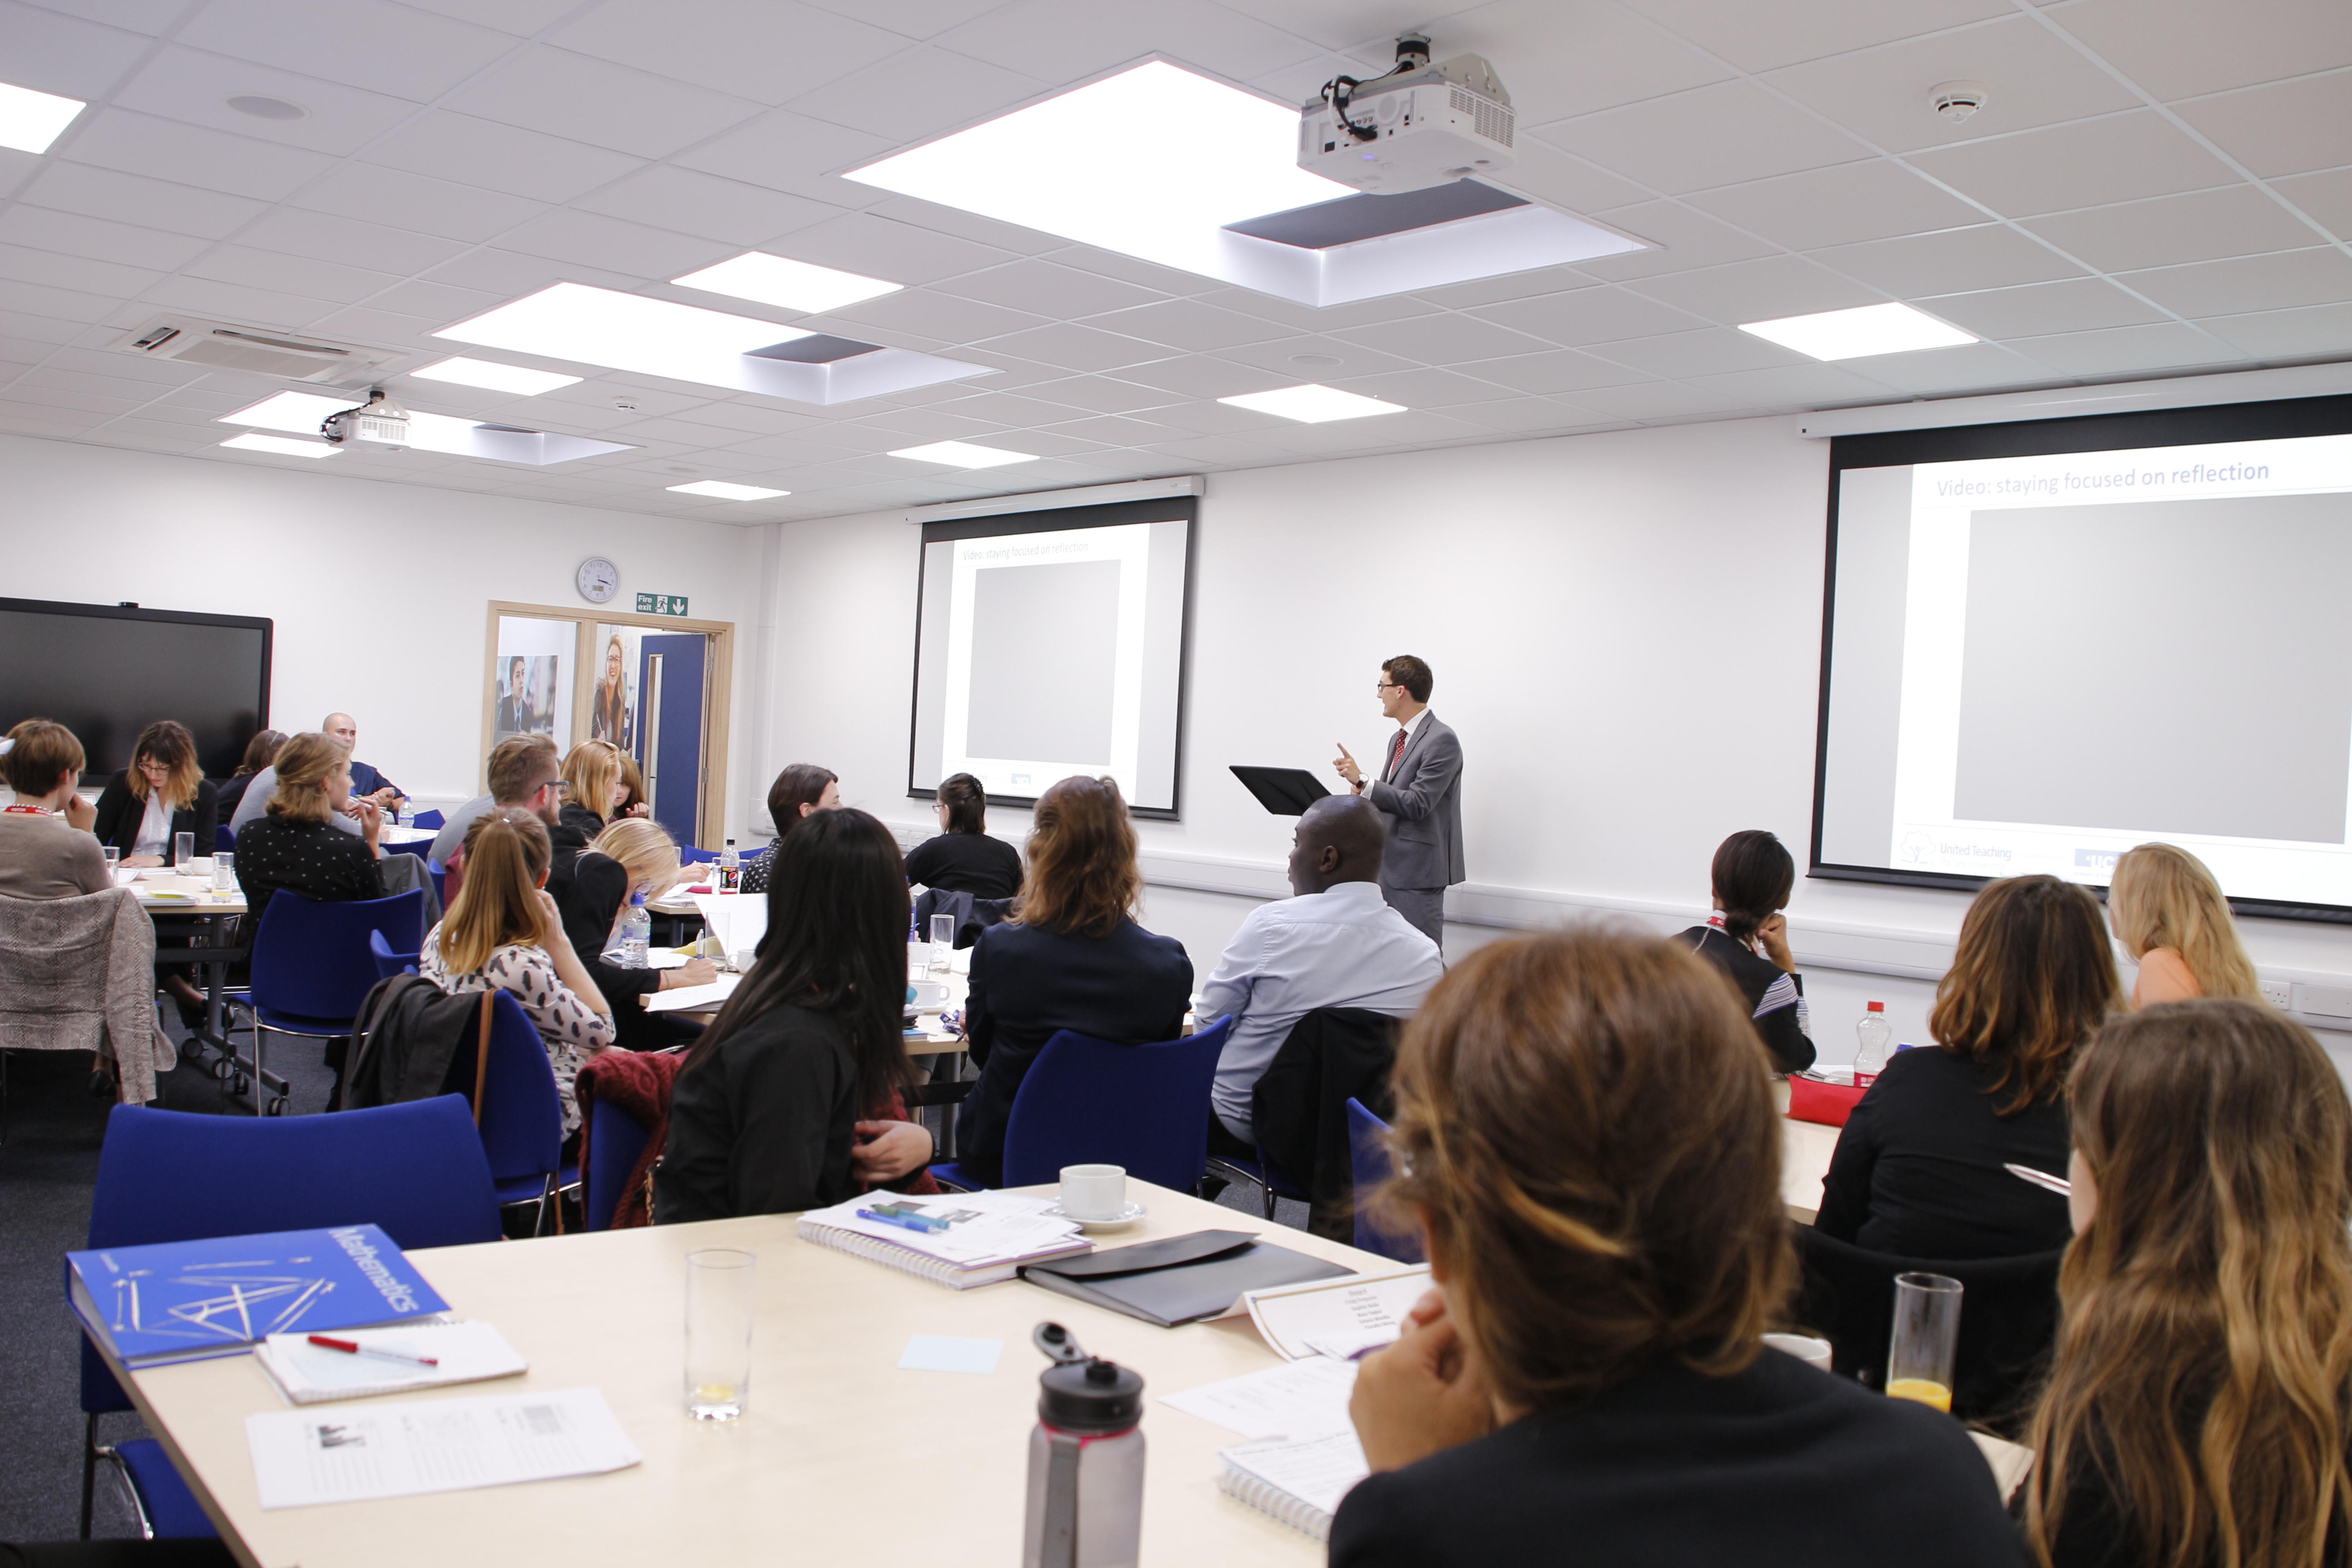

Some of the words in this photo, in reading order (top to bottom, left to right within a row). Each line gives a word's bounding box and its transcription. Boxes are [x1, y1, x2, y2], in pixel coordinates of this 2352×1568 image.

[1937, 479, 1991, 497] Video:
[1997, 475, 2059, 496] staying
[2064, 468, 2136, 490] focused
[2141, 471, 2165, 485] on
[2172, 462, 2269, 484] reflection
[963, 549, 985, 561] Video:
[986, 547, 1010, 560] staying
[1012, 544, 1039, 557] focused
[1041, 546, 1050, 554] on
[1052, 542, 1088, 554] reflection
[637, 603, 652, 612] exit
[638, 595, 652, 603] Fire
[1940, 843, 1970, 856] United
[1971, 846, 2011, 862] Teaching
[2090, 855, 2116, 868] UC
[328, 1227, 420, 1313] Mathematics
